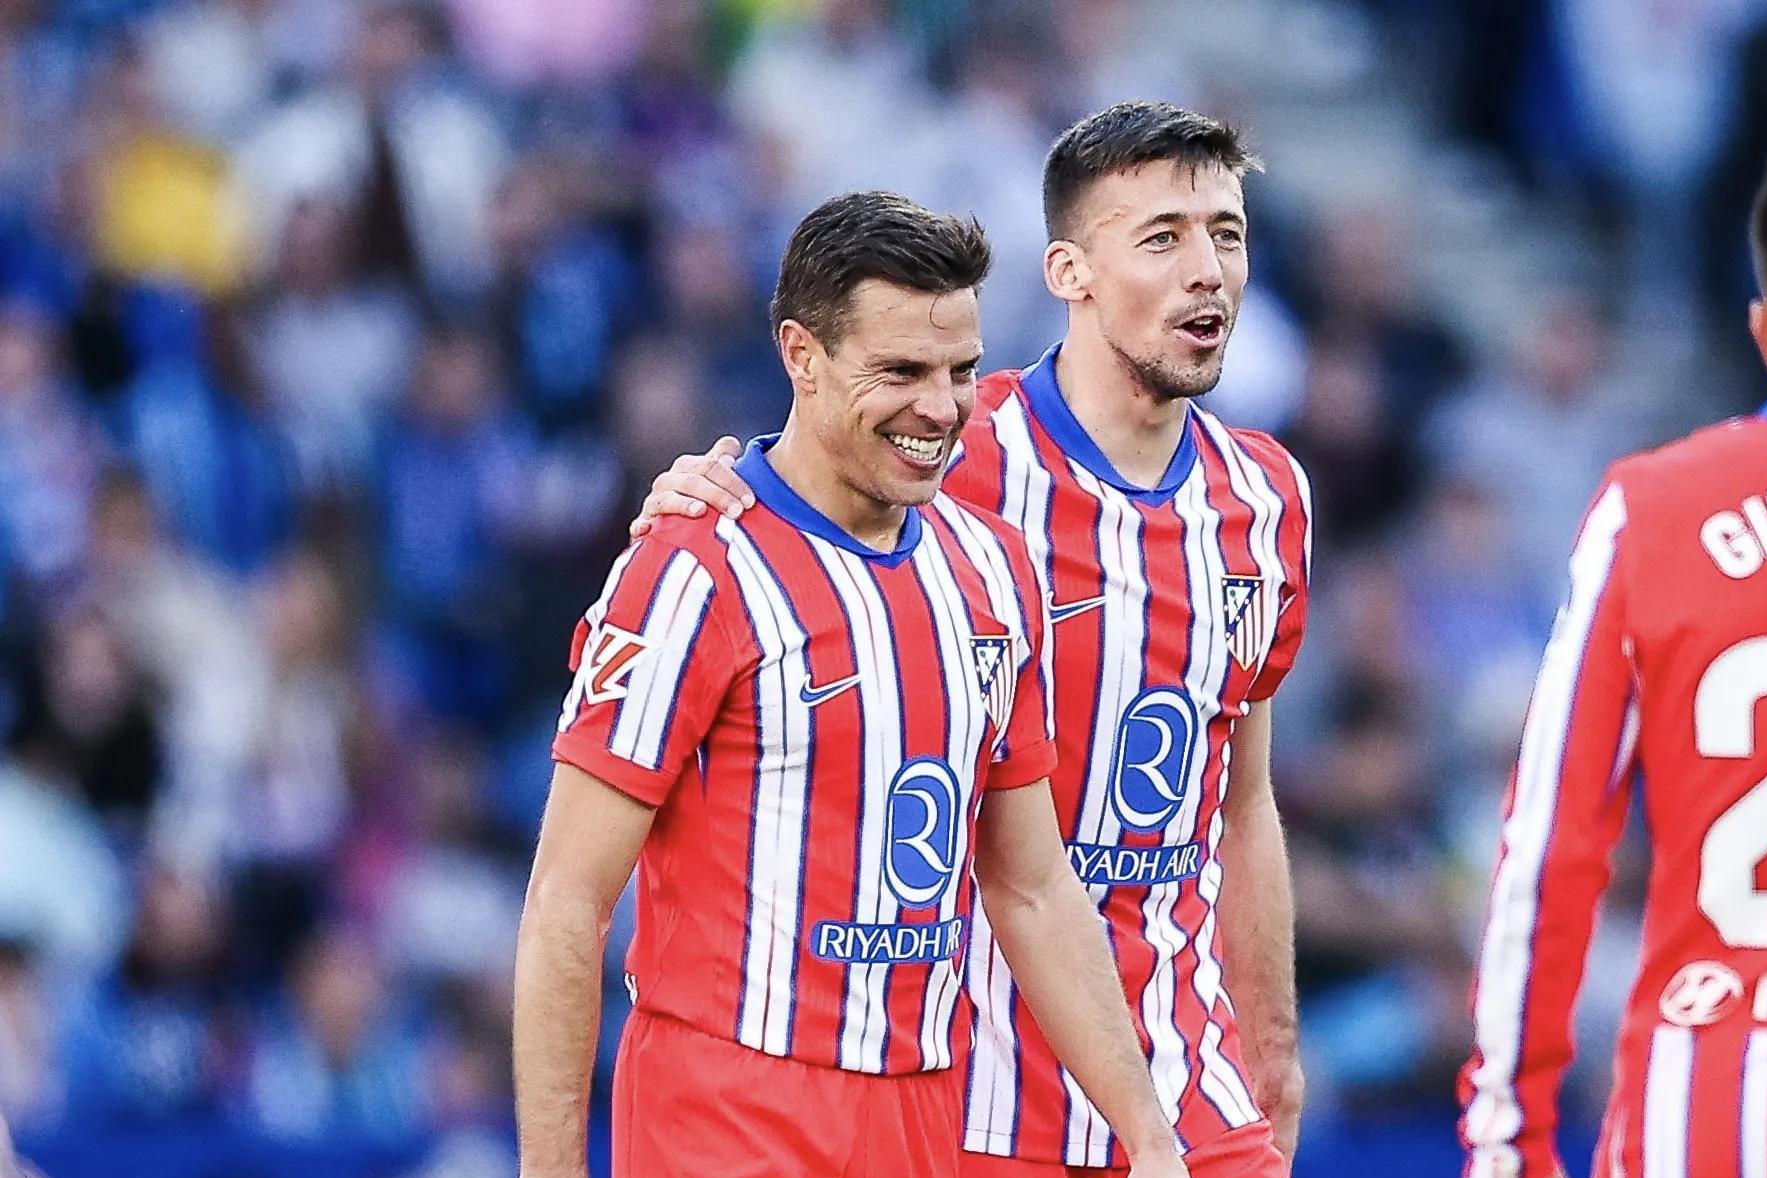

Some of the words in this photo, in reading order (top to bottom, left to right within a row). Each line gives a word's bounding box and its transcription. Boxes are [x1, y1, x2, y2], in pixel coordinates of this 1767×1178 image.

[1066, 845, 1161, 881] IYADH
[1161, 844, 1198, 879] AIR
[819, 924, 941, 959] RIYADH
